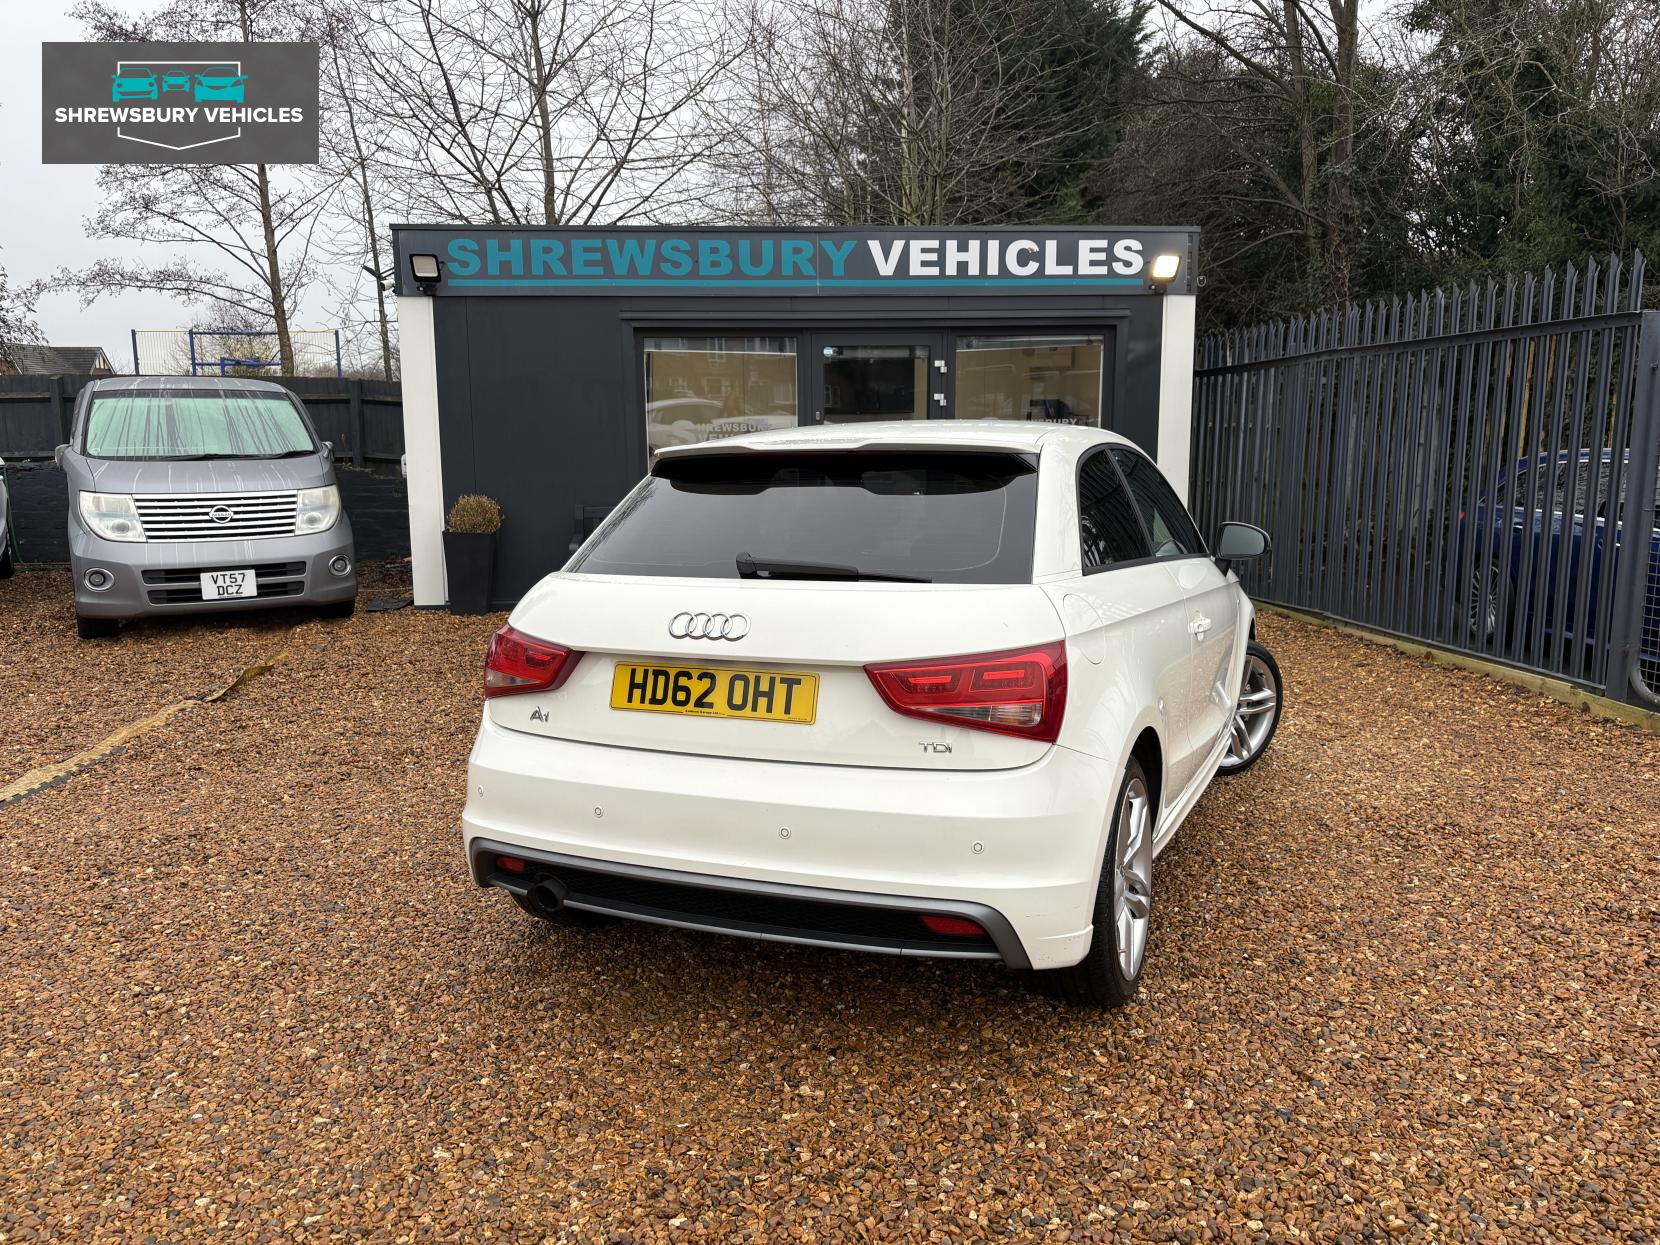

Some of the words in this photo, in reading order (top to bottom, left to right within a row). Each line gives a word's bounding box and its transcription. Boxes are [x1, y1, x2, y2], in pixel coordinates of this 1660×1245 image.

[447, 238, 857, 276] SHREWSBURY
[867, 238, 1144, 276] VEHICLES
[211, 572, 246, 584] VT57
[216, 584, 243, 596] DCZ
[627, 668, 716, 709] HD62
[726, 673, 802, 715] OHT
[530, 705, 550, 723] A1
[918, 741, 952, 753] TDI
